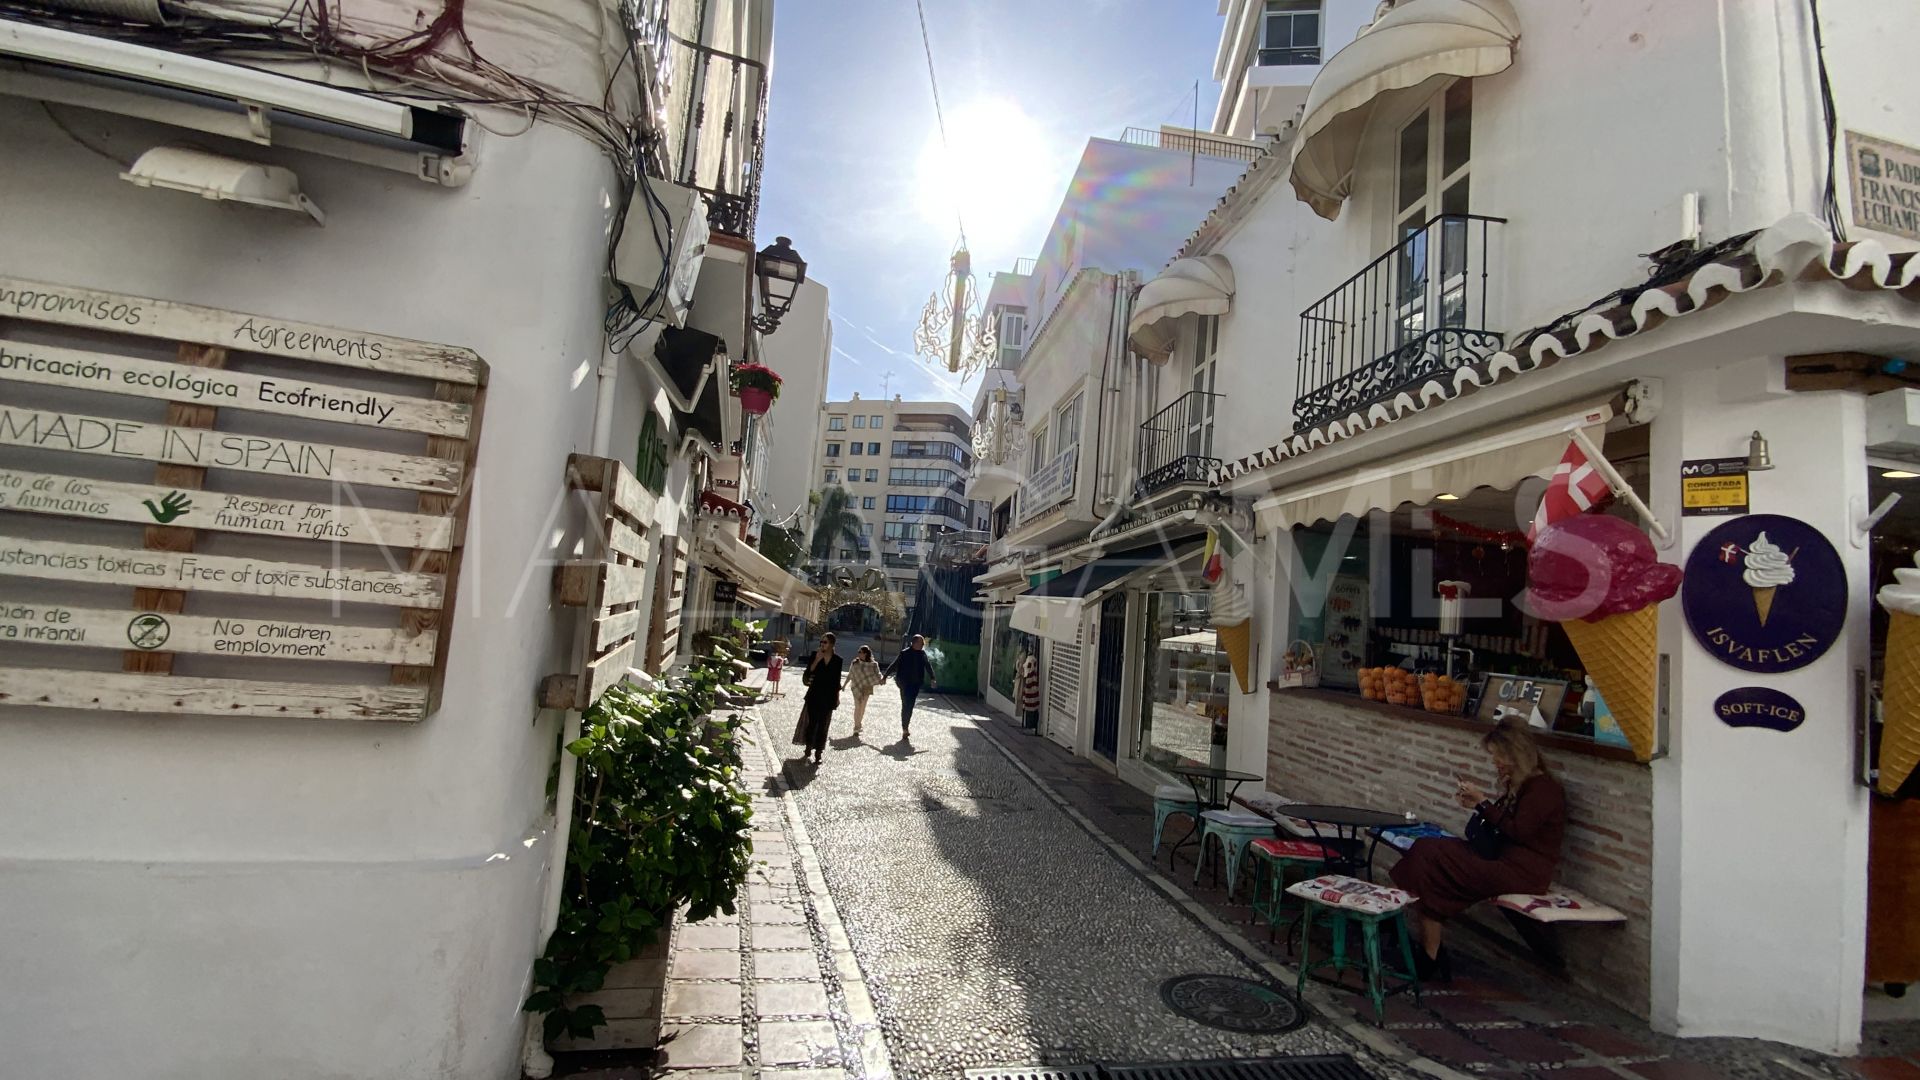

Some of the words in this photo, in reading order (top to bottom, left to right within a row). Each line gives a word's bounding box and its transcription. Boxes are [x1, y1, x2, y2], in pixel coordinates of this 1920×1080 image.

[123, 370, 238, 398] ecológica
[259, 381, 395, 423] Ecofriendly
[0, 410, 144, 456] MADE
[161, 428, 201, 462] IN
[215, 437, 335, 476] SPAIN
[32, 476, 54, 491] de
[1687, 480, 1741, 488] CONECTADA
[16, 489, 110, 514] humanos
[224, 495, 295, 519] Respect
[301, 503, 331, 521] for
[214, 512, 286, 533] human
[297, 521, 350, 539] rights
[179, 558, 226, 581] Free
[231, 564, 252, 583] of
[304, 571, 403, 595] substances
[44, 608, 71, 624] de
[24, 623, 86, 642] infantil
[213, 619, 245, 636] No
[214, 639, 327, 657] employment
[1706, 626, 1818, 664] ISVAFLEN
[1720, 702, 1800, 722] SOFT-ICE
